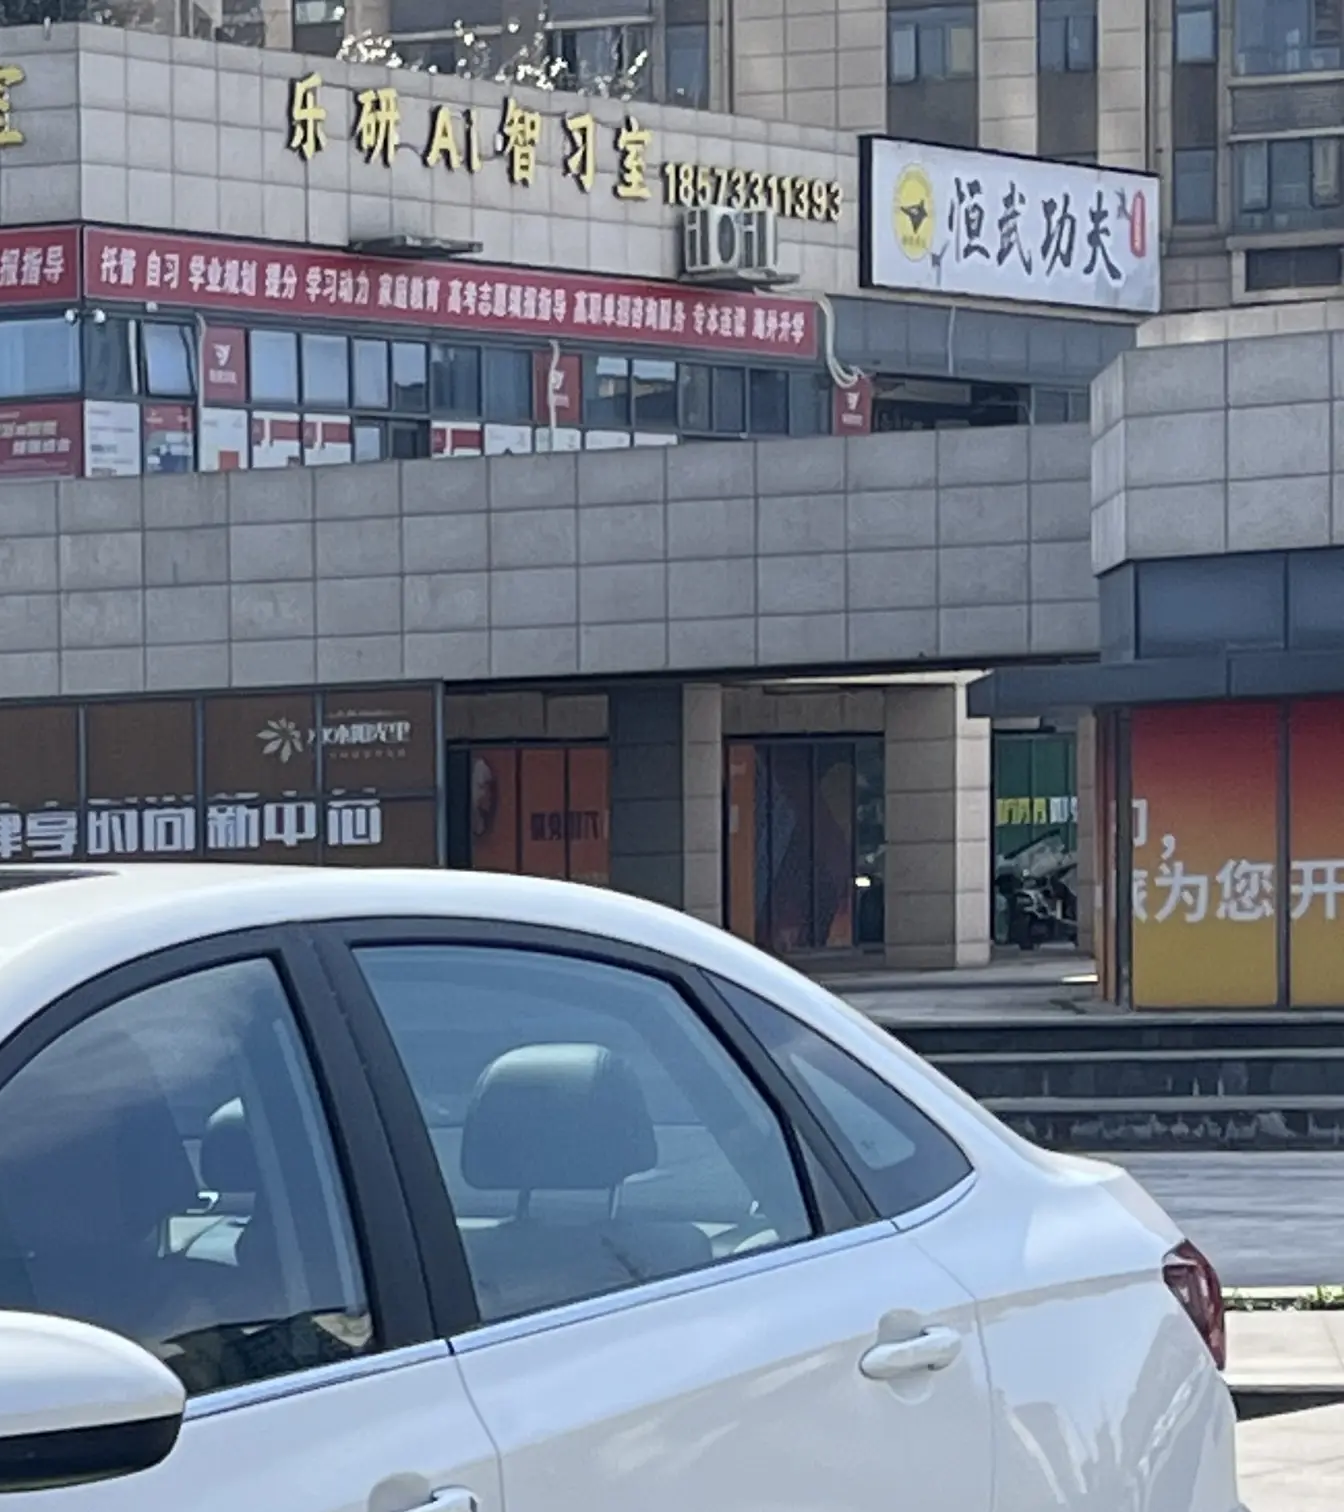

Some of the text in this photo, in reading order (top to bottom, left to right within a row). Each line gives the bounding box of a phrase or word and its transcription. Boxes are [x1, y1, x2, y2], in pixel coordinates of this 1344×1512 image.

[948, 177, 1122, 280] 恒武功夫
[146, 250, 180, 289] 自习
